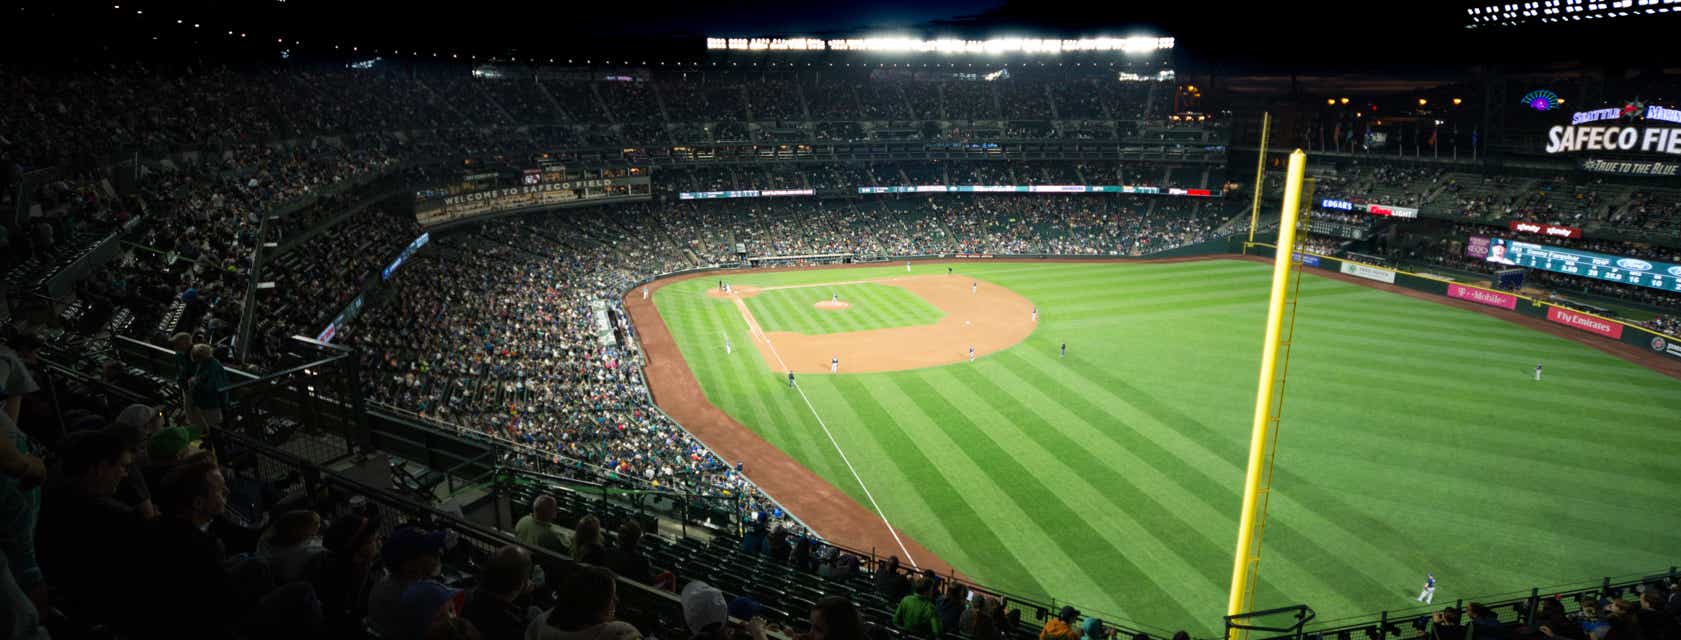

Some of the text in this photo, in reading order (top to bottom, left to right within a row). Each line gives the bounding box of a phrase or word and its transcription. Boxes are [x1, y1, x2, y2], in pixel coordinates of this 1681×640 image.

[1545, 126, 1638, 154] SAFECO
[1650, 161, 1680, 176] BLUE
[445, 179, 612, 205] WELCOME TO SAFECO FIELD
[1556, 311, 1611, 333] Fly Emirates
